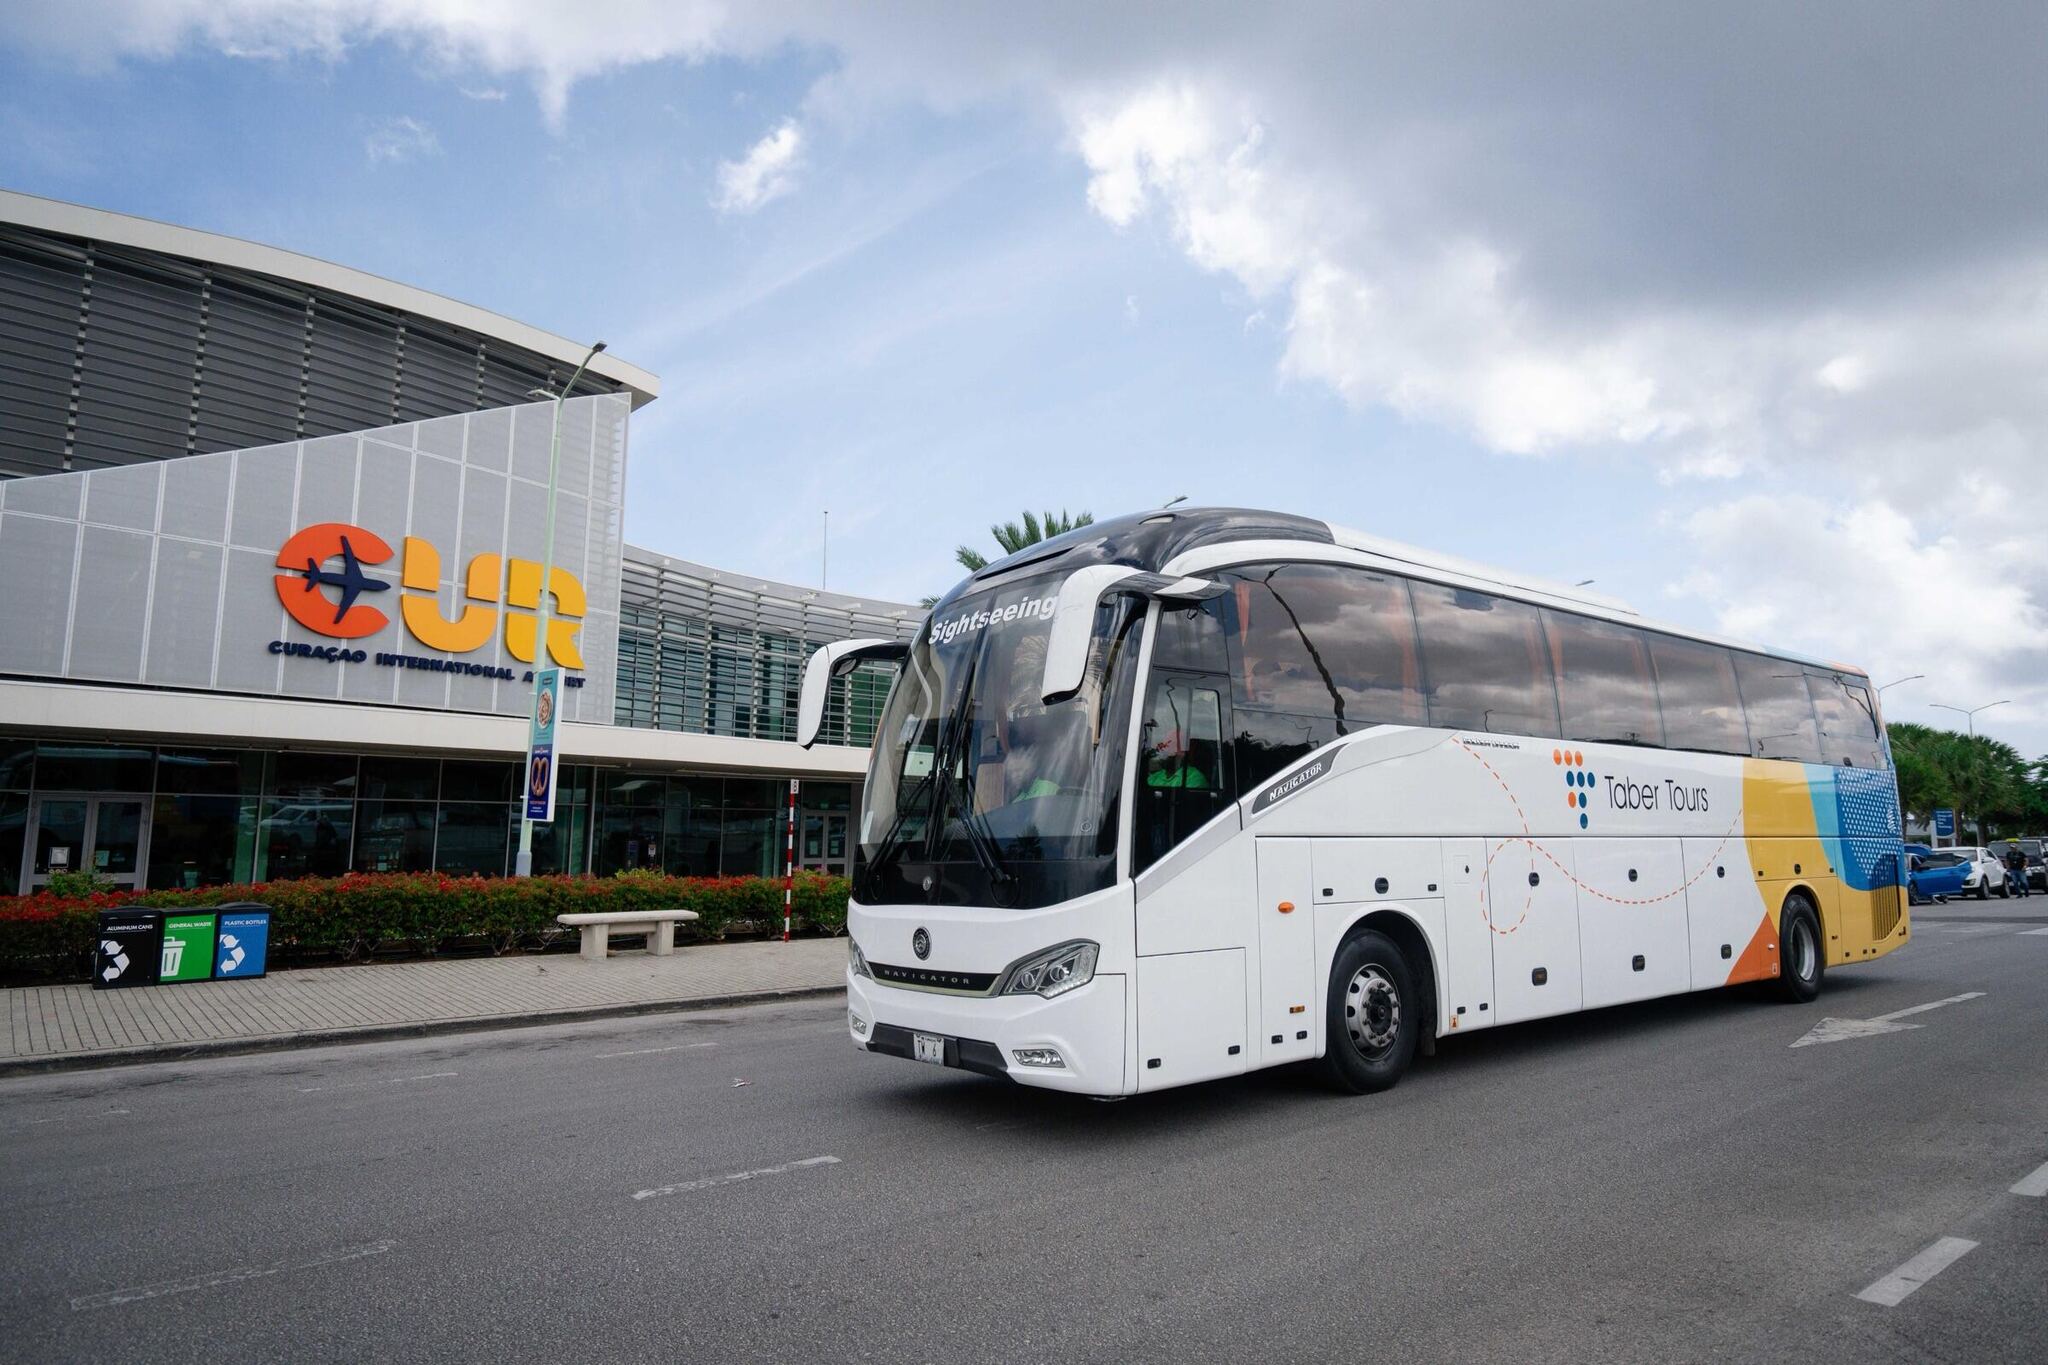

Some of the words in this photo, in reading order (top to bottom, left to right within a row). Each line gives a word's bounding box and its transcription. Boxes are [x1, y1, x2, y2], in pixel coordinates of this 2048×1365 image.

[274, 523, 587, 671] CUR
[928, 595, 1059, 644] Sightseeing
[268, 640, 367, 664] CURAÇAO
[375, 652, 515, 681] INTERNATIONAL
[1269, 762, 1322, 802] NAVIGATOR
[1604, 775, 1659, 810] Taber
[1665, 779, 1709, 812] Tours
[884, 969, 970, 984] NAVIGATOR
